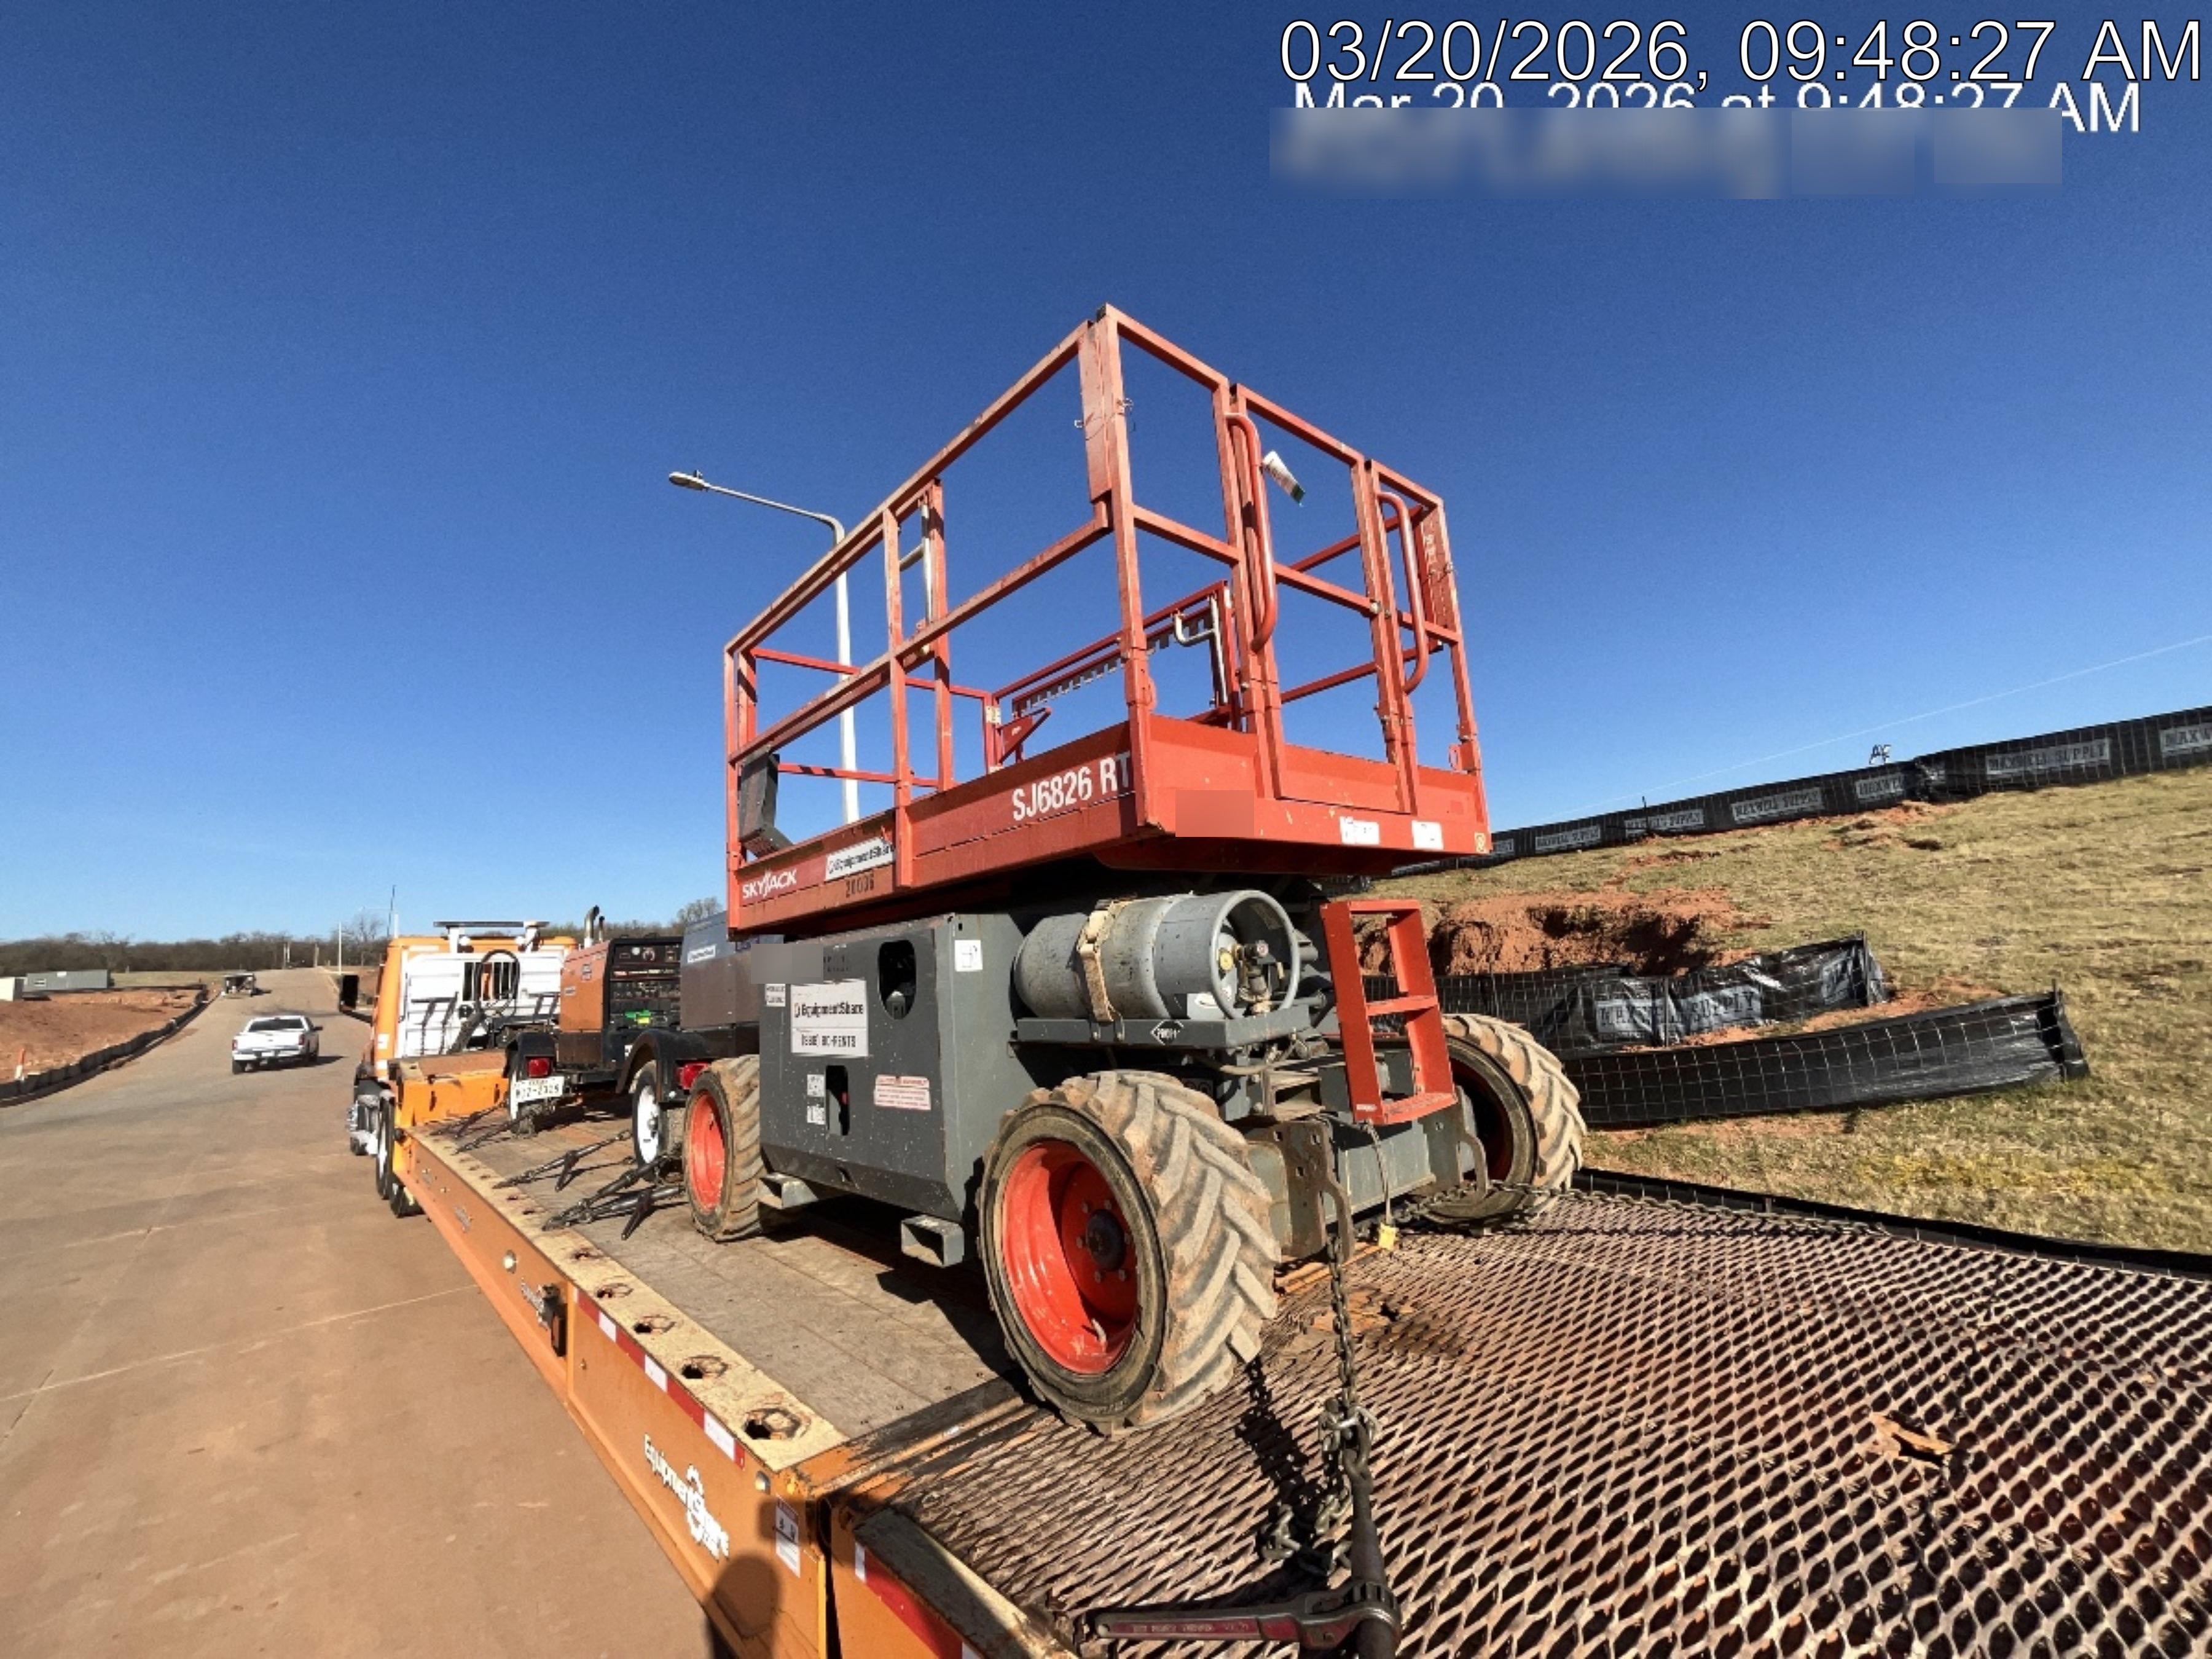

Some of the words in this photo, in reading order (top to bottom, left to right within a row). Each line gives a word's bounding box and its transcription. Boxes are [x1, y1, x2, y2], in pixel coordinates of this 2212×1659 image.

[1012, 766, 1092, 821] SJ6826
[1099, 750, 1131, 796] RT
[742, 868, 798, 898] SKYJACK
